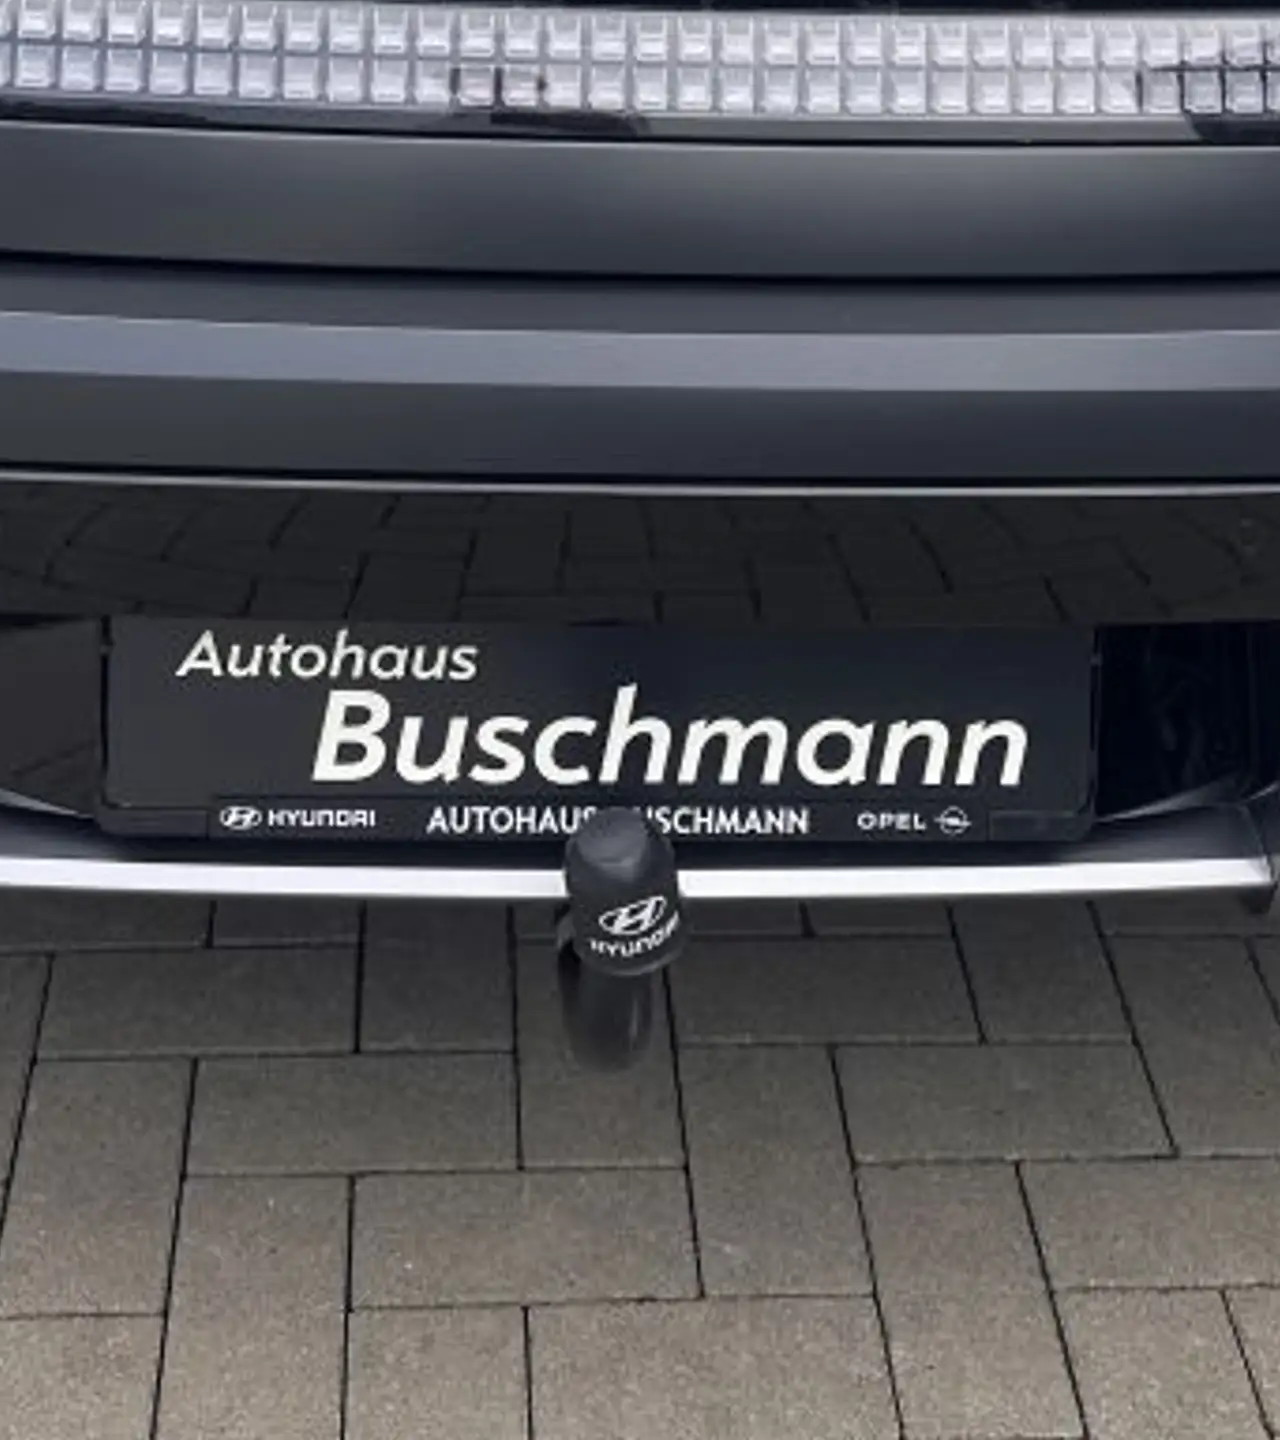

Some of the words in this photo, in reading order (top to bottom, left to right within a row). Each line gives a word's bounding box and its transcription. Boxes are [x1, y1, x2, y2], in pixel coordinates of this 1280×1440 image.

[175, 629, 478, 680] Autohaus
[311, 683, 1028, 786] Buschmann
[267, 808, 377, 828] HYUNDAI
[632, 806, 809, 835] SCHMANN
[856, 811, 927, 831] OPEL
[589, 909, 679, 957] HYUNDAI
